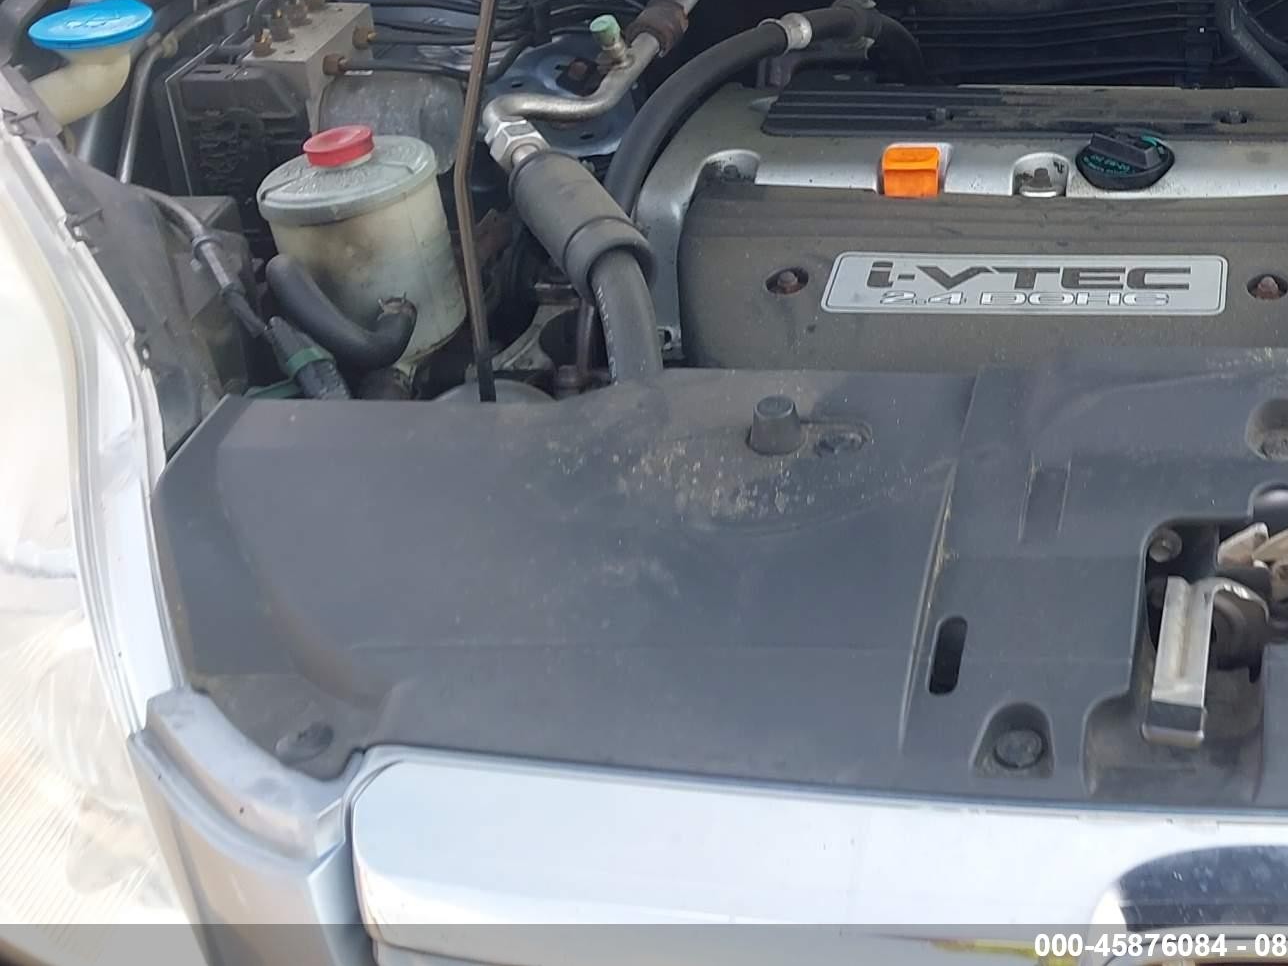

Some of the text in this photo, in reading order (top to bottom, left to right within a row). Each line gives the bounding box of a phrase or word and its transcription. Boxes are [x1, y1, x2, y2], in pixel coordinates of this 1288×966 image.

[866, 261, 1191, 290] i-VTEC
[880, 290, 1170, 306] 2.4 DOHC
